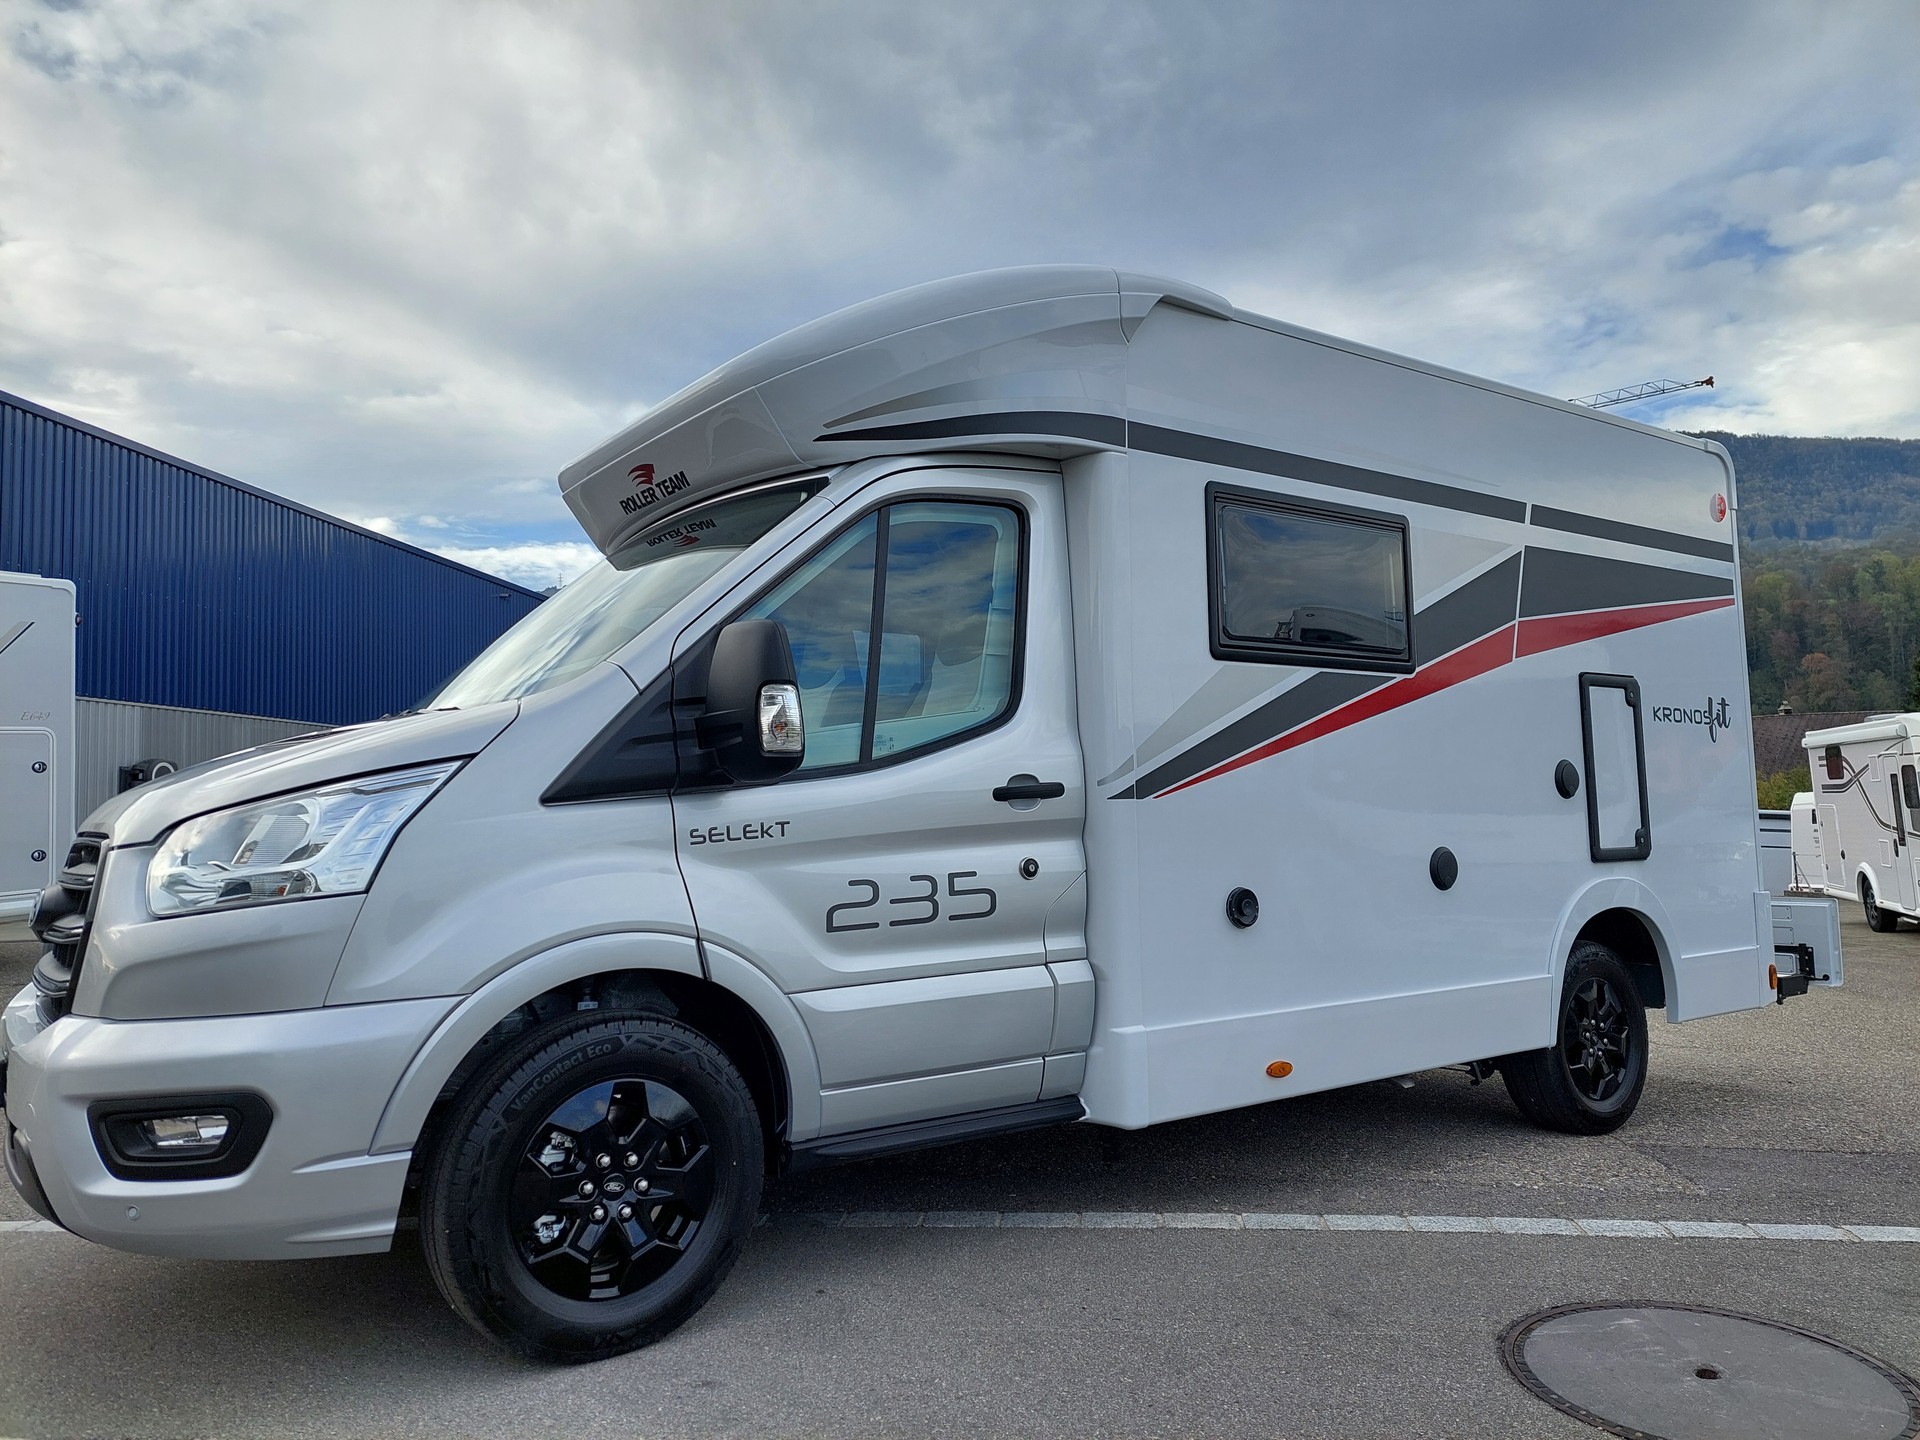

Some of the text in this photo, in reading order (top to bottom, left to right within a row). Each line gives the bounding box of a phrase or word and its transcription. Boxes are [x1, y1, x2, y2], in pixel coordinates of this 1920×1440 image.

[619, 470, 691, 515] ROLLER TEAM
[825, 870, 998, 934] 235
[510, 1042, 613, 1111] VanContact Eco
